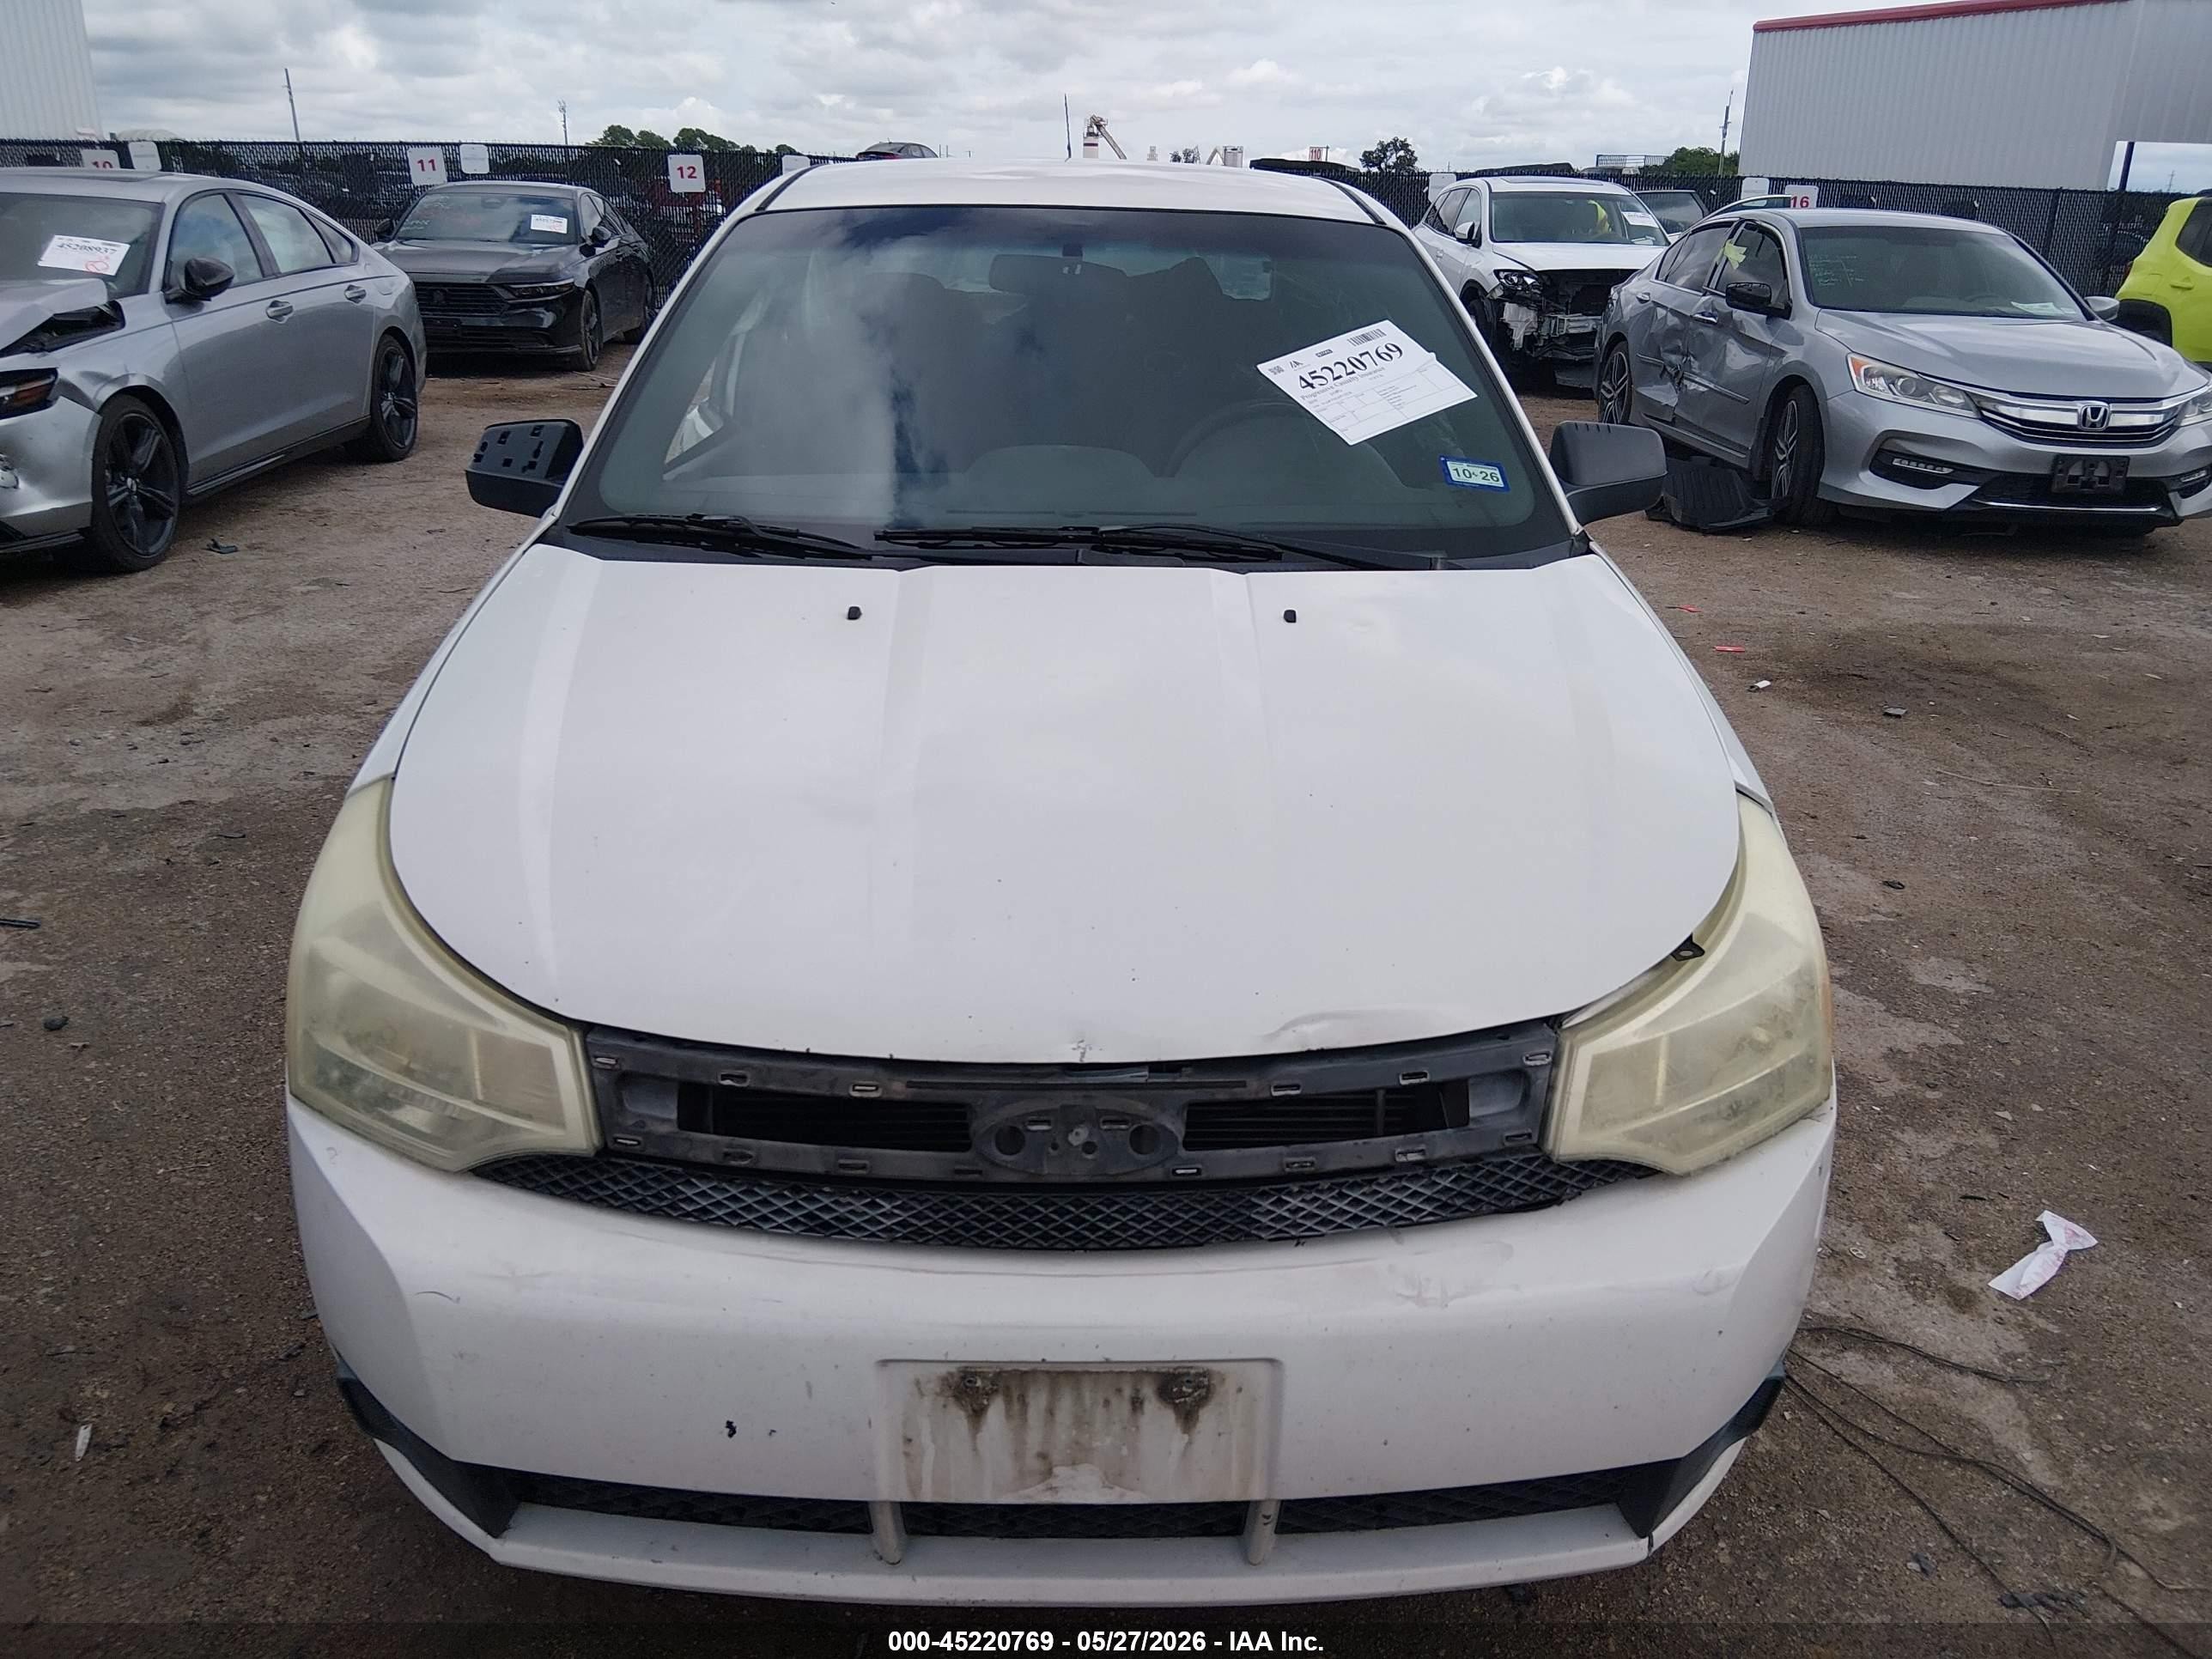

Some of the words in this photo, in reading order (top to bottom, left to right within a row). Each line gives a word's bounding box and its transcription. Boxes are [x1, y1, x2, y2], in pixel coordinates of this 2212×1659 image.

[1310, 149, 1322, 160] 110
[417, 159, 436, 172] 11
[677, 166, 697, 179] 12
[1791, 196, 1809, 208] 16
[1298, 342, 1403, 390] 45220769
